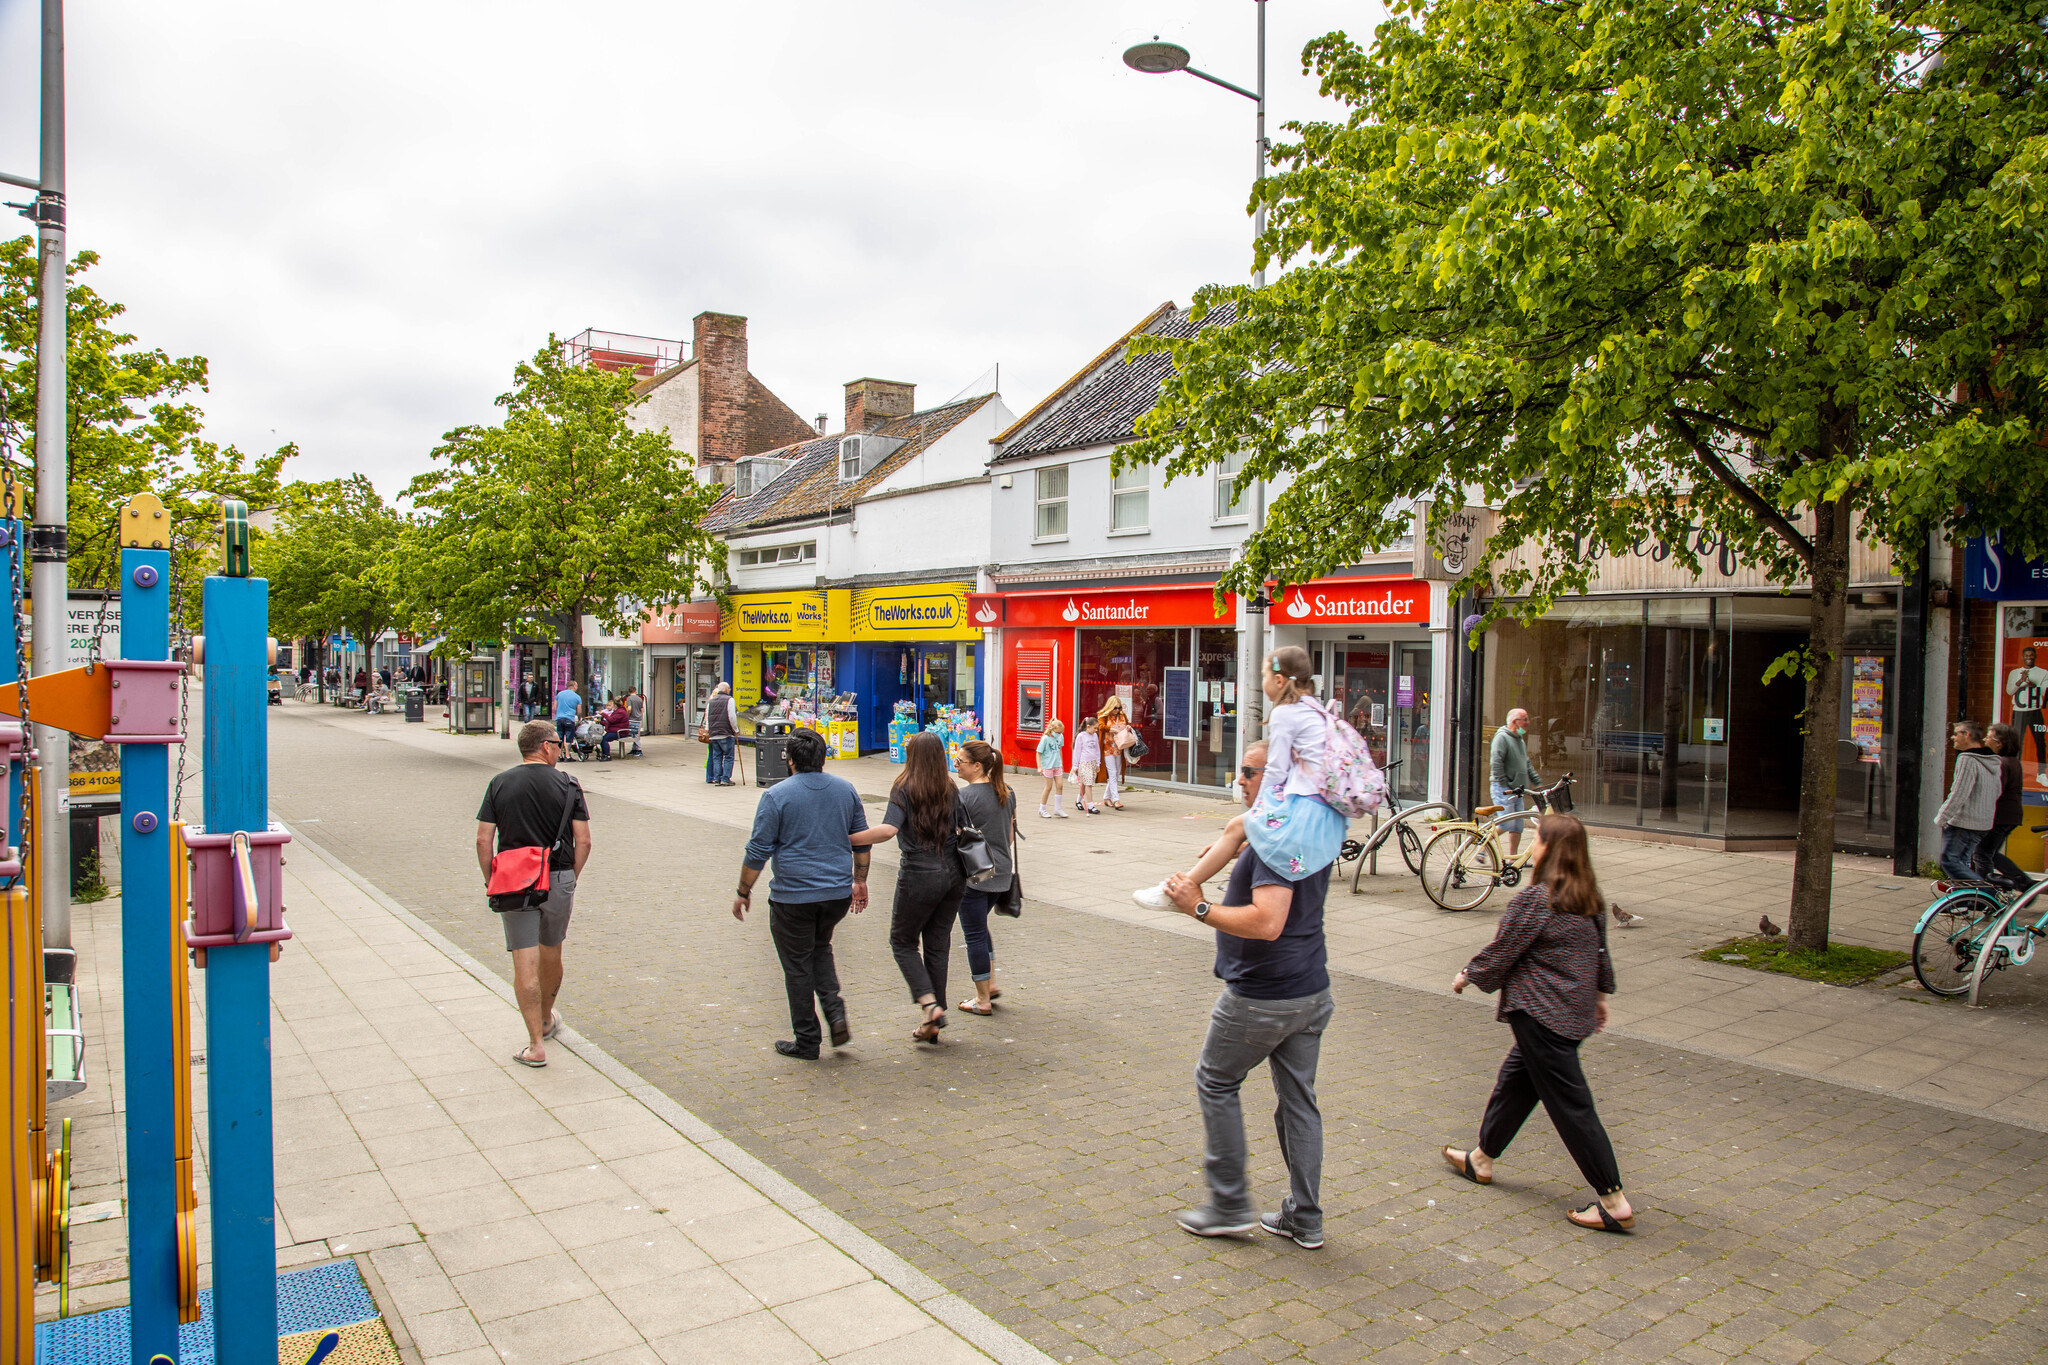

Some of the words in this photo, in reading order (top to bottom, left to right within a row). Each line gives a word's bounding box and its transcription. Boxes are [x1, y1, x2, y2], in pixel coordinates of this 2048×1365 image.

[801, 603, 816, 611] The
[874, 602, 952, 621] TheWorks.co.uk
[1082, 599, 1149, 620] Santander
[1315, 590, 1414, 616] Santander
[656, 612, 683, 631] Rym
[742, 609, 792, 624] TheWorks.co.
[796, 612, 822, 620] Works
[822, 667, 831, 681] £5
